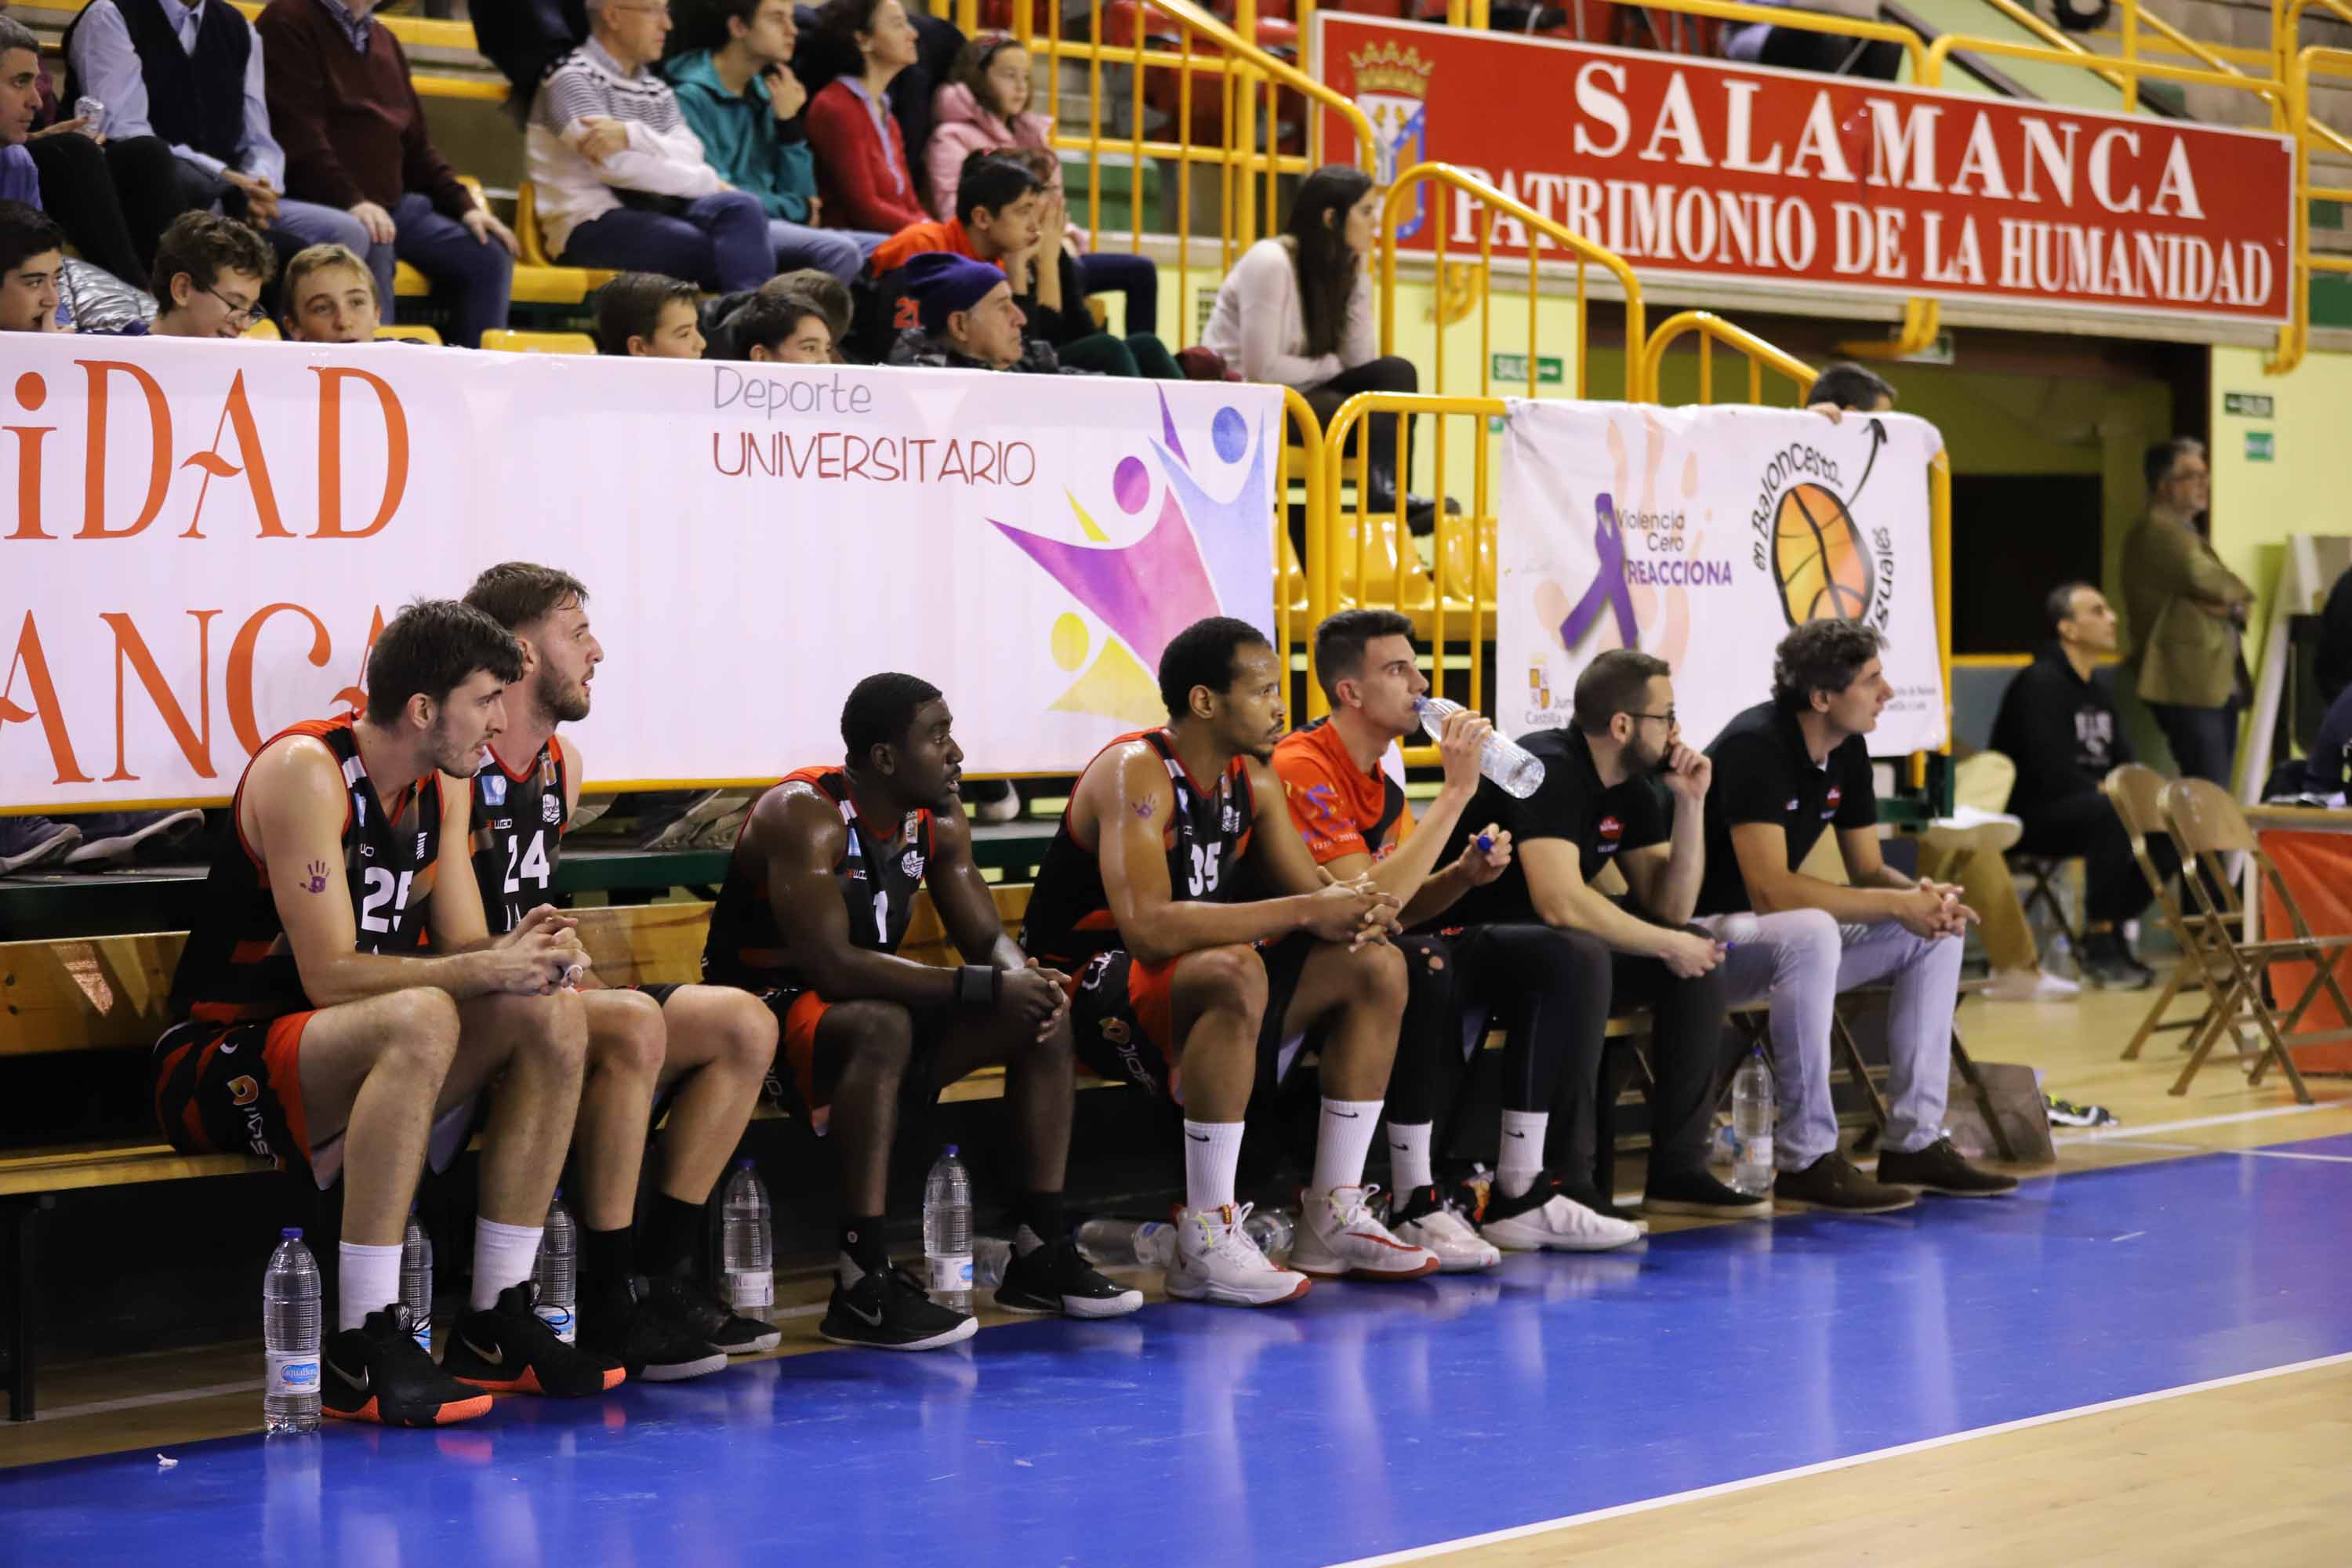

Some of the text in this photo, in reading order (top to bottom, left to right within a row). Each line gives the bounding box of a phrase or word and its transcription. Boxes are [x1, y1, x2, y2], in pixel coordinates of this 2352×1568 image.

[1573, 60, 2206, 220] SALAMANCA
[1450, 165, 2274, 307] PATRIMONIO DE LA HUMANIDAD
[713, 365, 872, 421] Deporte
[713, 430, 1036, 486] UNIVERSITARIO
[1615, 510, 1686, 530] Violencia
[1647, 532, 1684, 552] Cero
[1626, 560, 1733, 586] REACCIONA
[503, 829, 550, 895] 24
[1188, 840, 1222, 897] 35
[873, 889, 888, 944] 1
